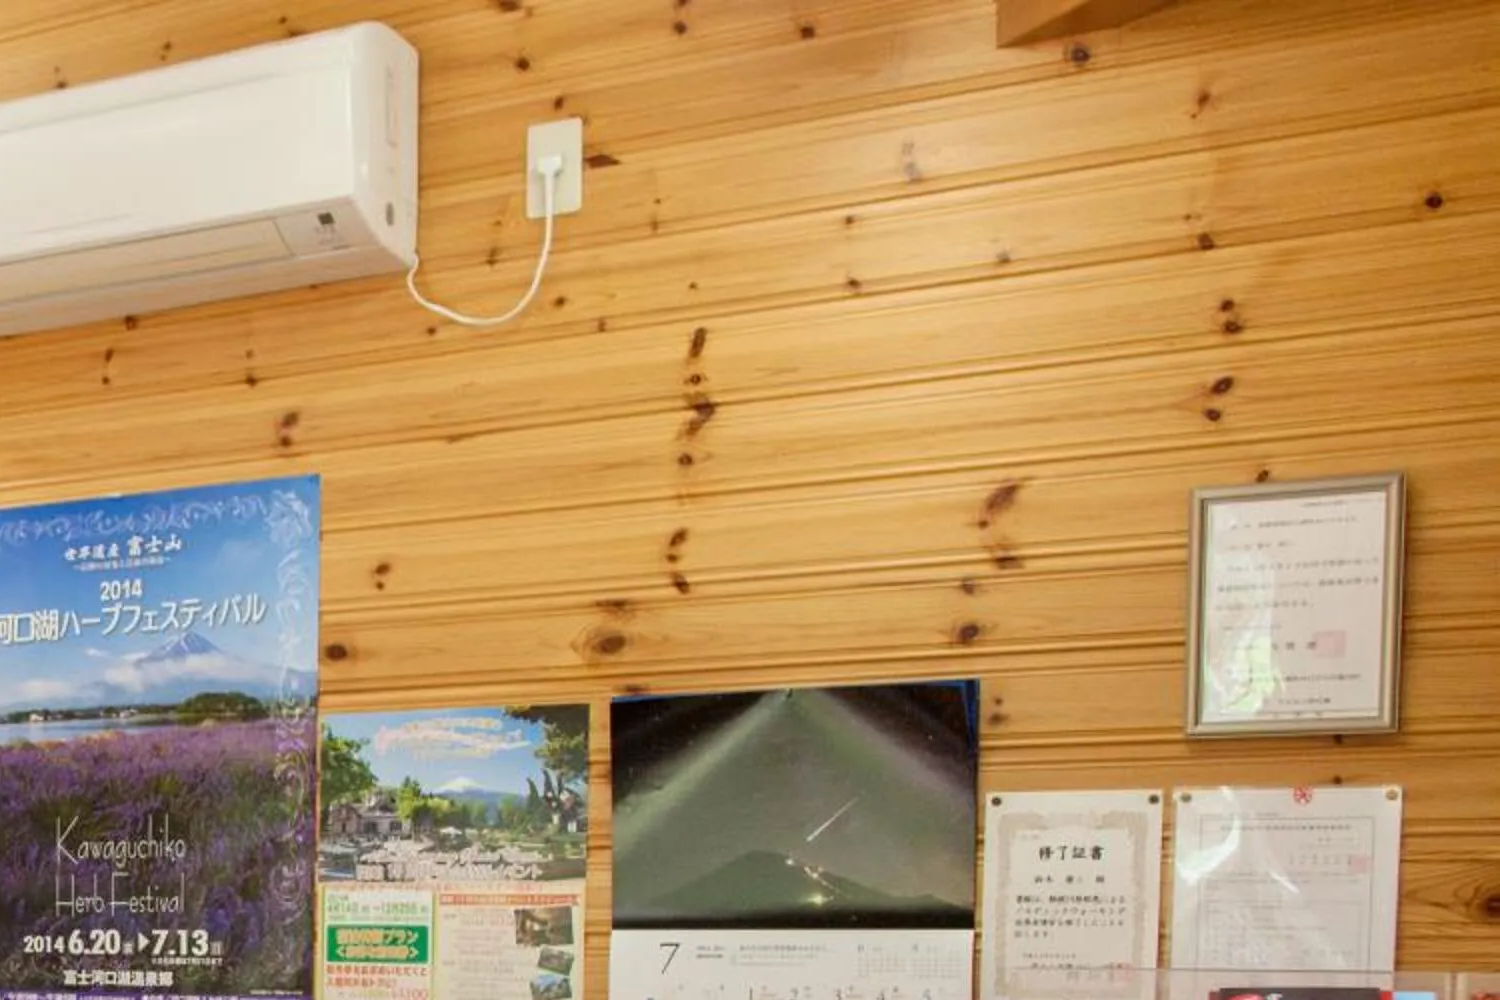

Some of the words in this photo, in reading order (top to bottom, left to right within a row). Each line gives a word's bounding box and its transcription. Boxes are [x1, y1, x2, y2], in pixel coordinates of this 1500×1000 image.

[126, 534, 183, 557] 富士山
[100, 578, 144, 601] 2014
[55, 813, 186, 870] Kawaguchiko
[54, 873, 106, 918] Herb
[109, 871, 186, 918] Festival
[22, 935, 66, 954] 2014
[67, 928, 121, 956] 6.20
[151, 928, 210, 956] 7.13
[659, 941, 682, 975] 7
[62, 969, 175, 988] 富士河口湖温泉郷
